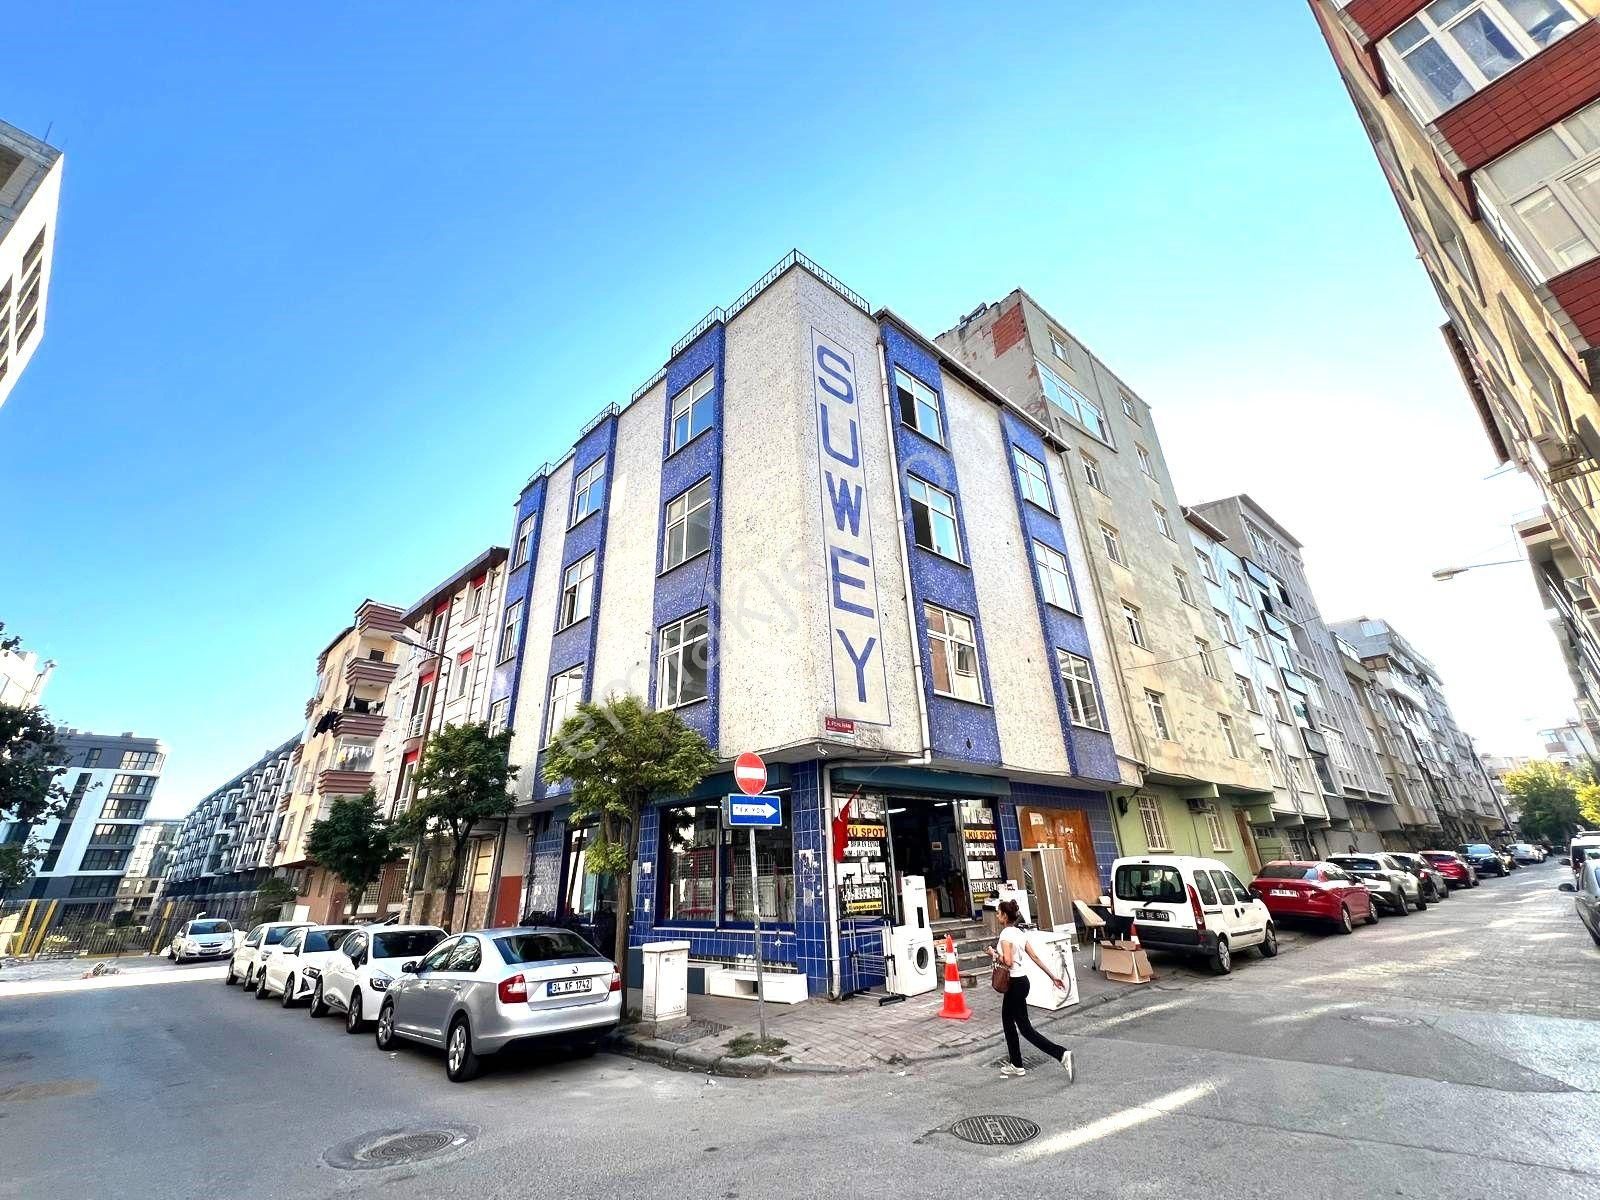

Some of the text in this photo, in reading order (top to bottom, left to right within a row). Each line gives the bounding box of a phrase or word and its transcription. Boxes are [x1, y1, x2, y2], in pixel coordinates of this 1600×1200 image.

[816, 345, 877, 703] SUWEY
[847, 826, 884, 838] KÜ SPOT
[980, 831, 996, 840] SPOT
[552, 979, 590, 992] 34 XF 1742
